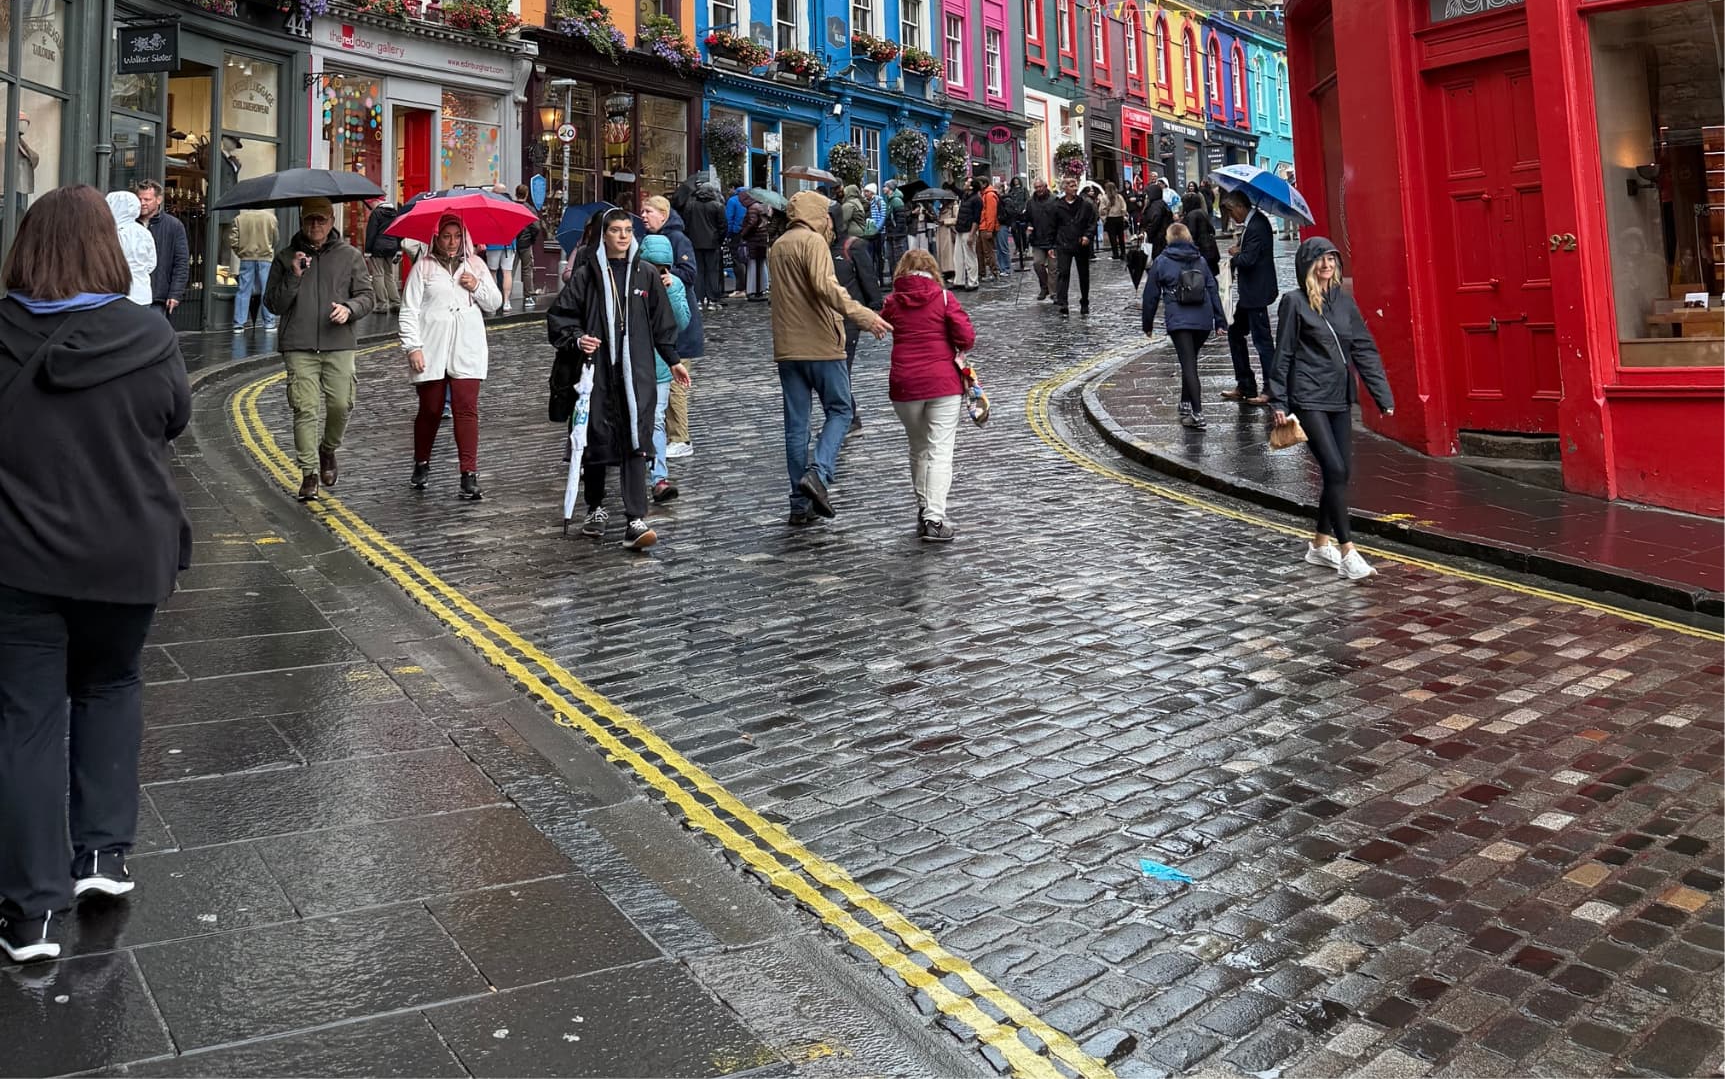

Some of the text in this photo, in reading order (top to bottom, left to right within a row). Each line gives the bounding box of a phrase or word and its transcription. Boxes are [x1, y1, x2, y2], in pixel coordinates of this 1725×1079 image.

[329, 29, 405, 58] the red door gallery
[124, 53, 173, 64] Walker Slater
[560, 127, 574, 138] 20
[1549, 233, 1577, 252] 92
